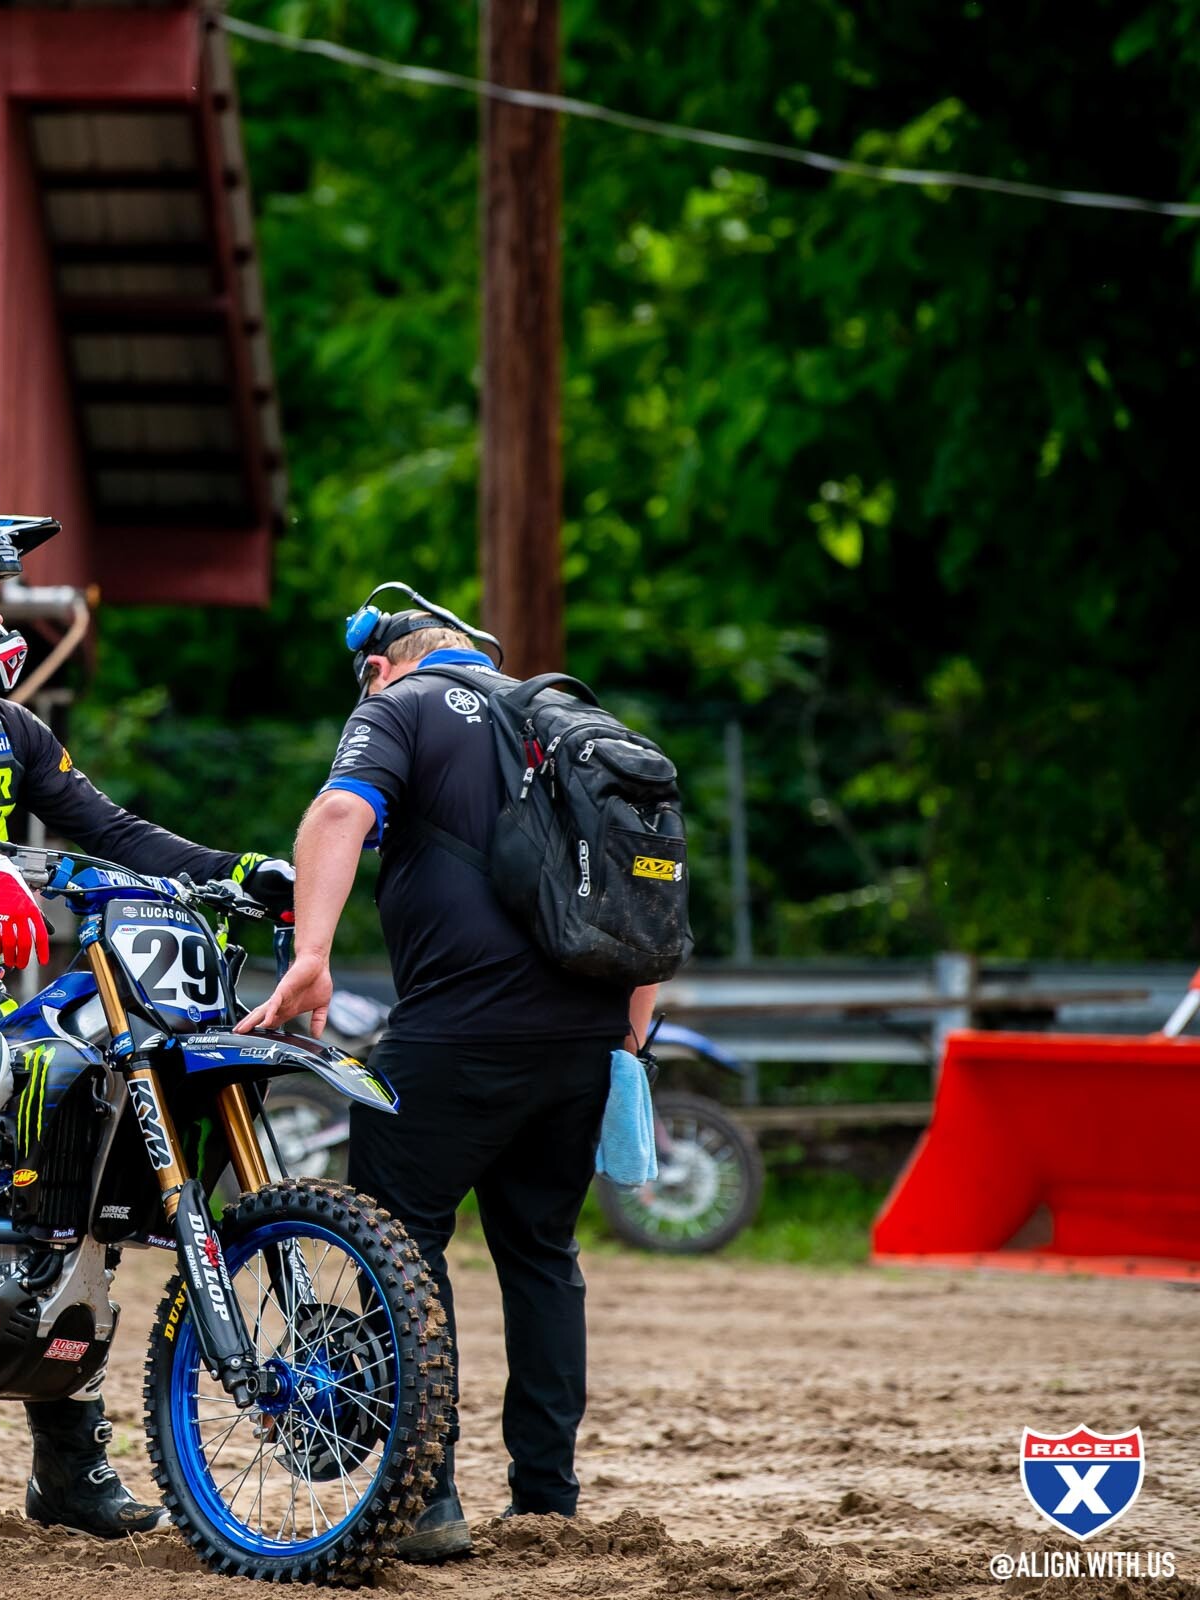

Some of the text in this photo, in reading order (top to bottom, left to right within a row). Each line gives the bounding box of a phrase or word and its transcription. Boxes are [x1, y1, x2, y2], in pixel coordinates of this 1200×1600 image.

[140, 907, 174, 918] LUCAS
[175, 911, 191, 923] OIL
[132, 929, 219, 1005] 29
[195, 1035, 220, 1044] YAMAHA
[184, 1244, 204, 1290] BRAKING
[187, 1212, 230, 1321] DUNLOP
[164, 1280, 188, 1342] DUN
[46, 1349, 83, 1360] SPEED
[52, 1339, 88, 1352] LIGHT
